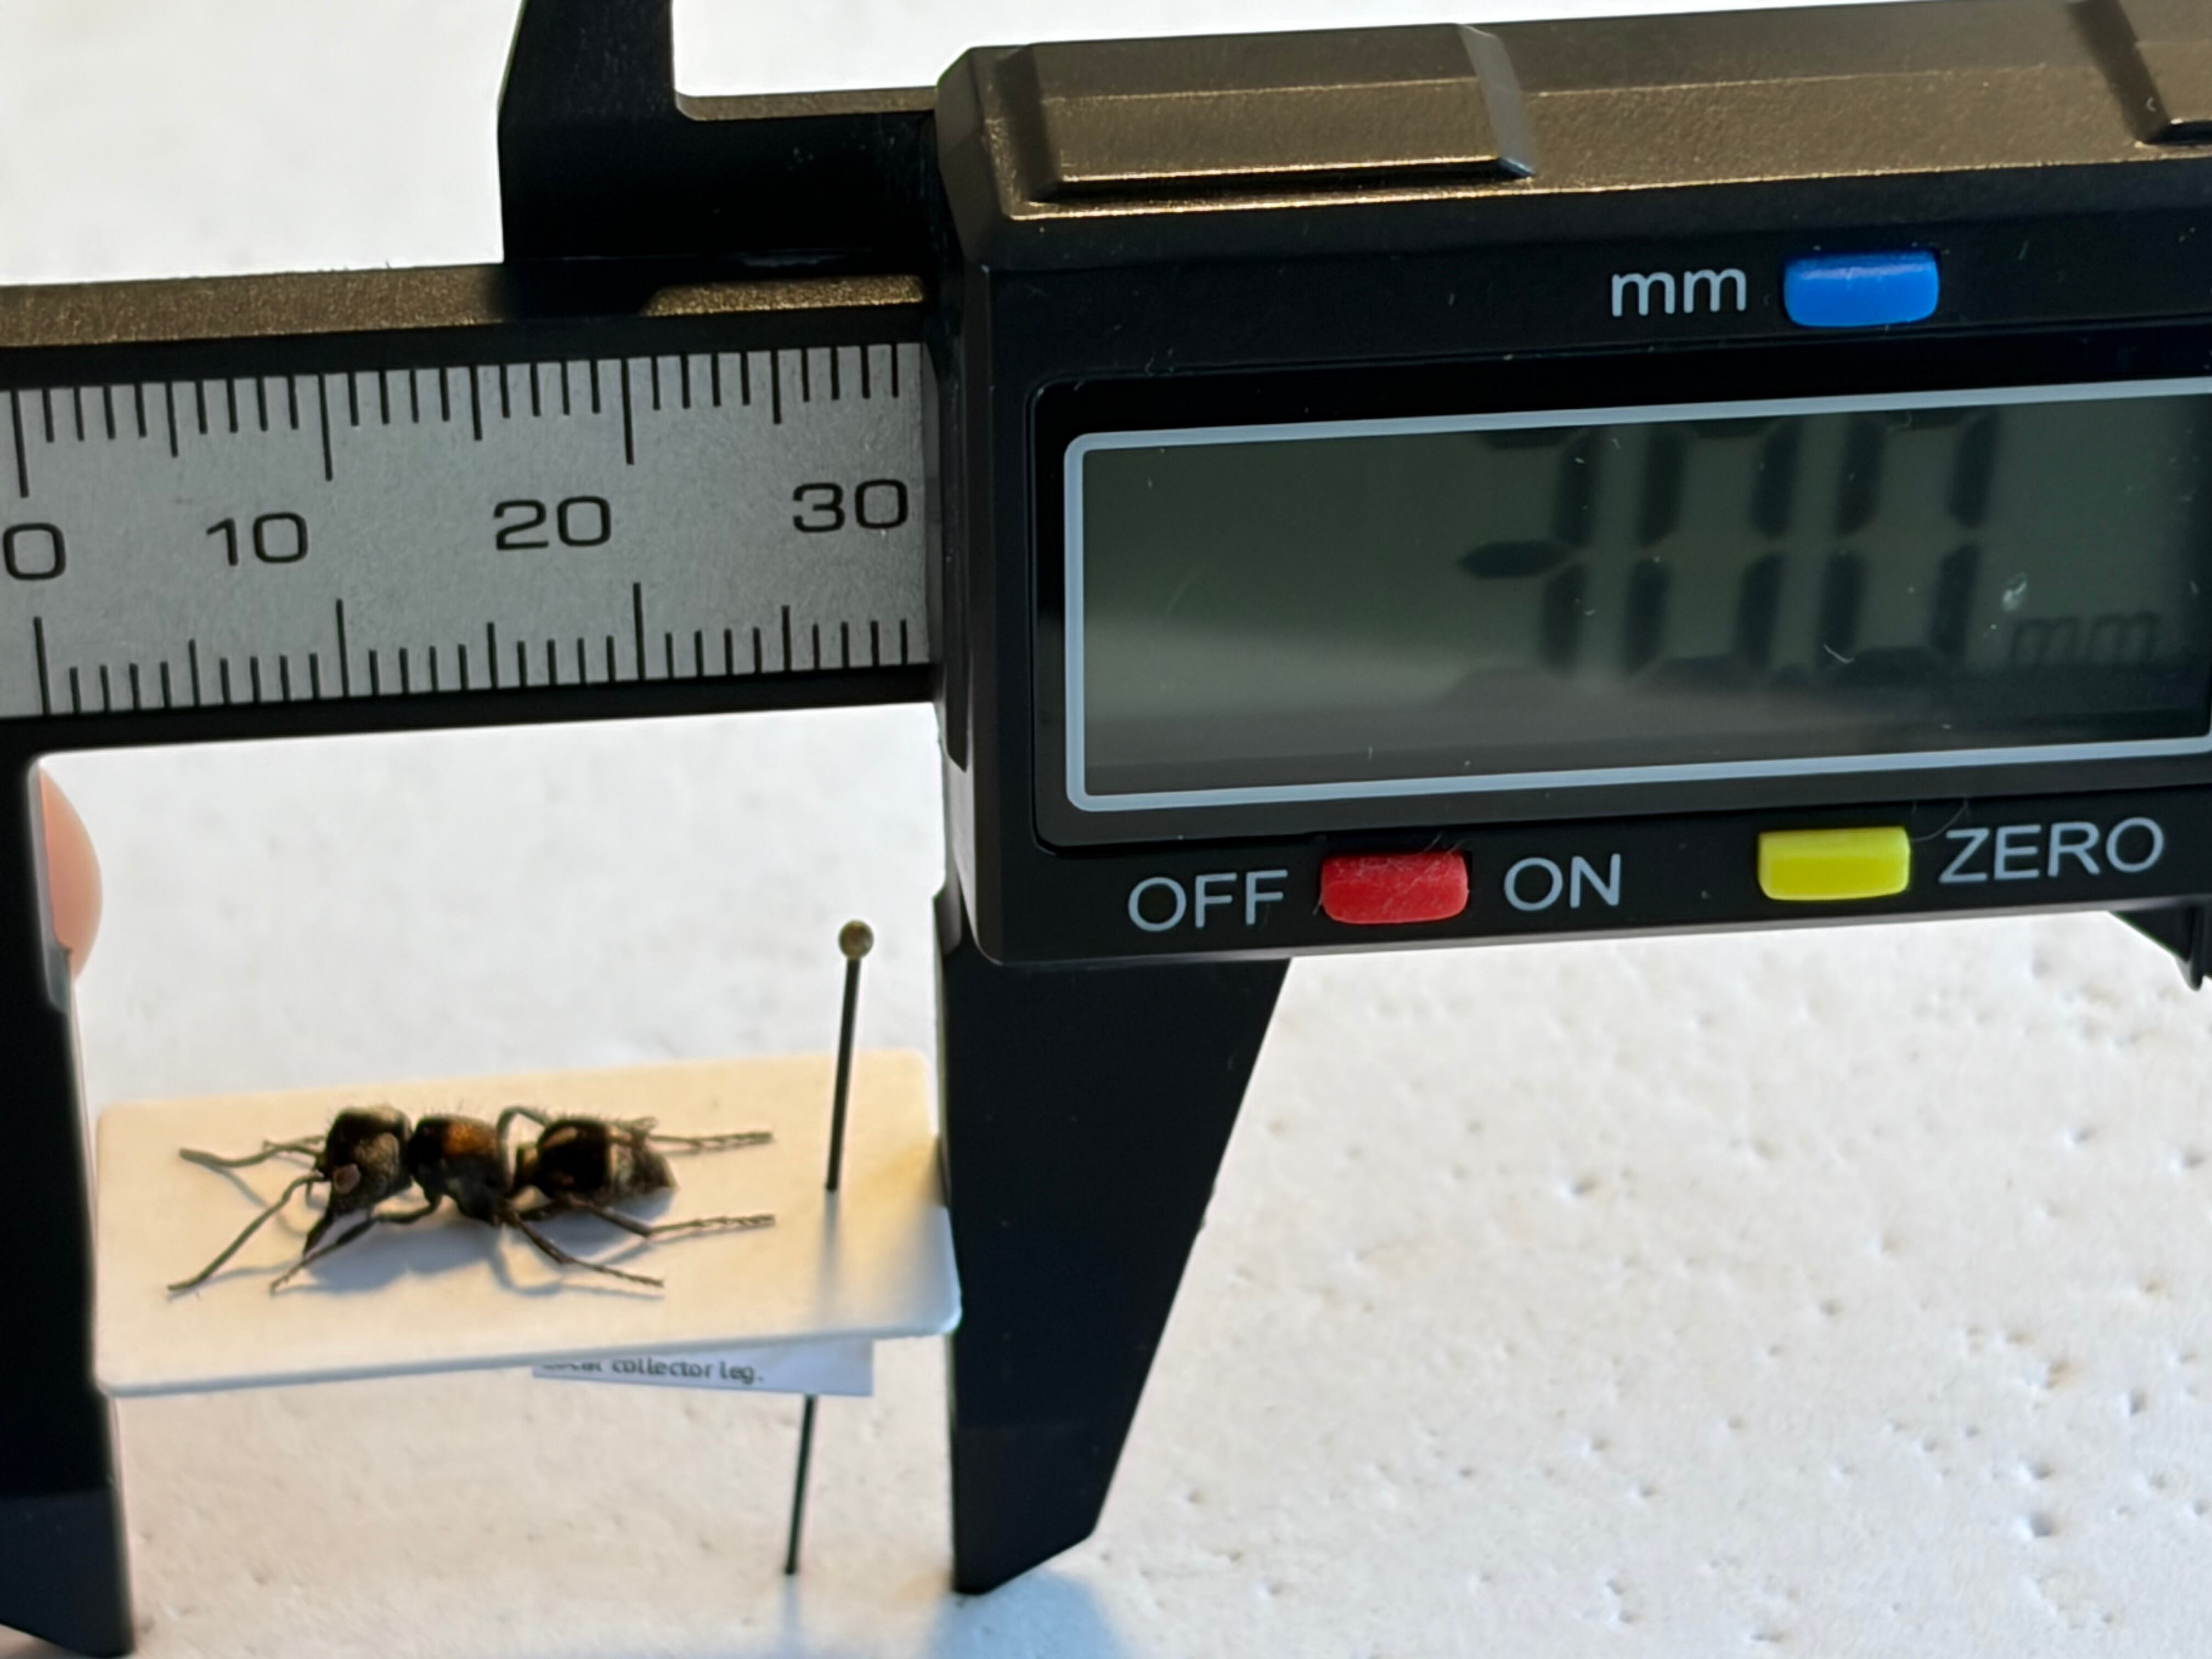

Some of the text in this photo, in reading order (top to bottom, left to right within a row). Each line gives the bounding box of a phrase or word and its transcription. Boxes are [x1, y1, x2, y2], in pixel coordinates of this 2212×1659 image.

[1611, 268, 1747, 317] mm
[2, 478, 909, 581] 0 10 20 30
[2009, 610, 2159, 664] mm
[1128, 817, 2164, 932] OFF ON ZERO
[611, 1356, 713, 1379] collector
